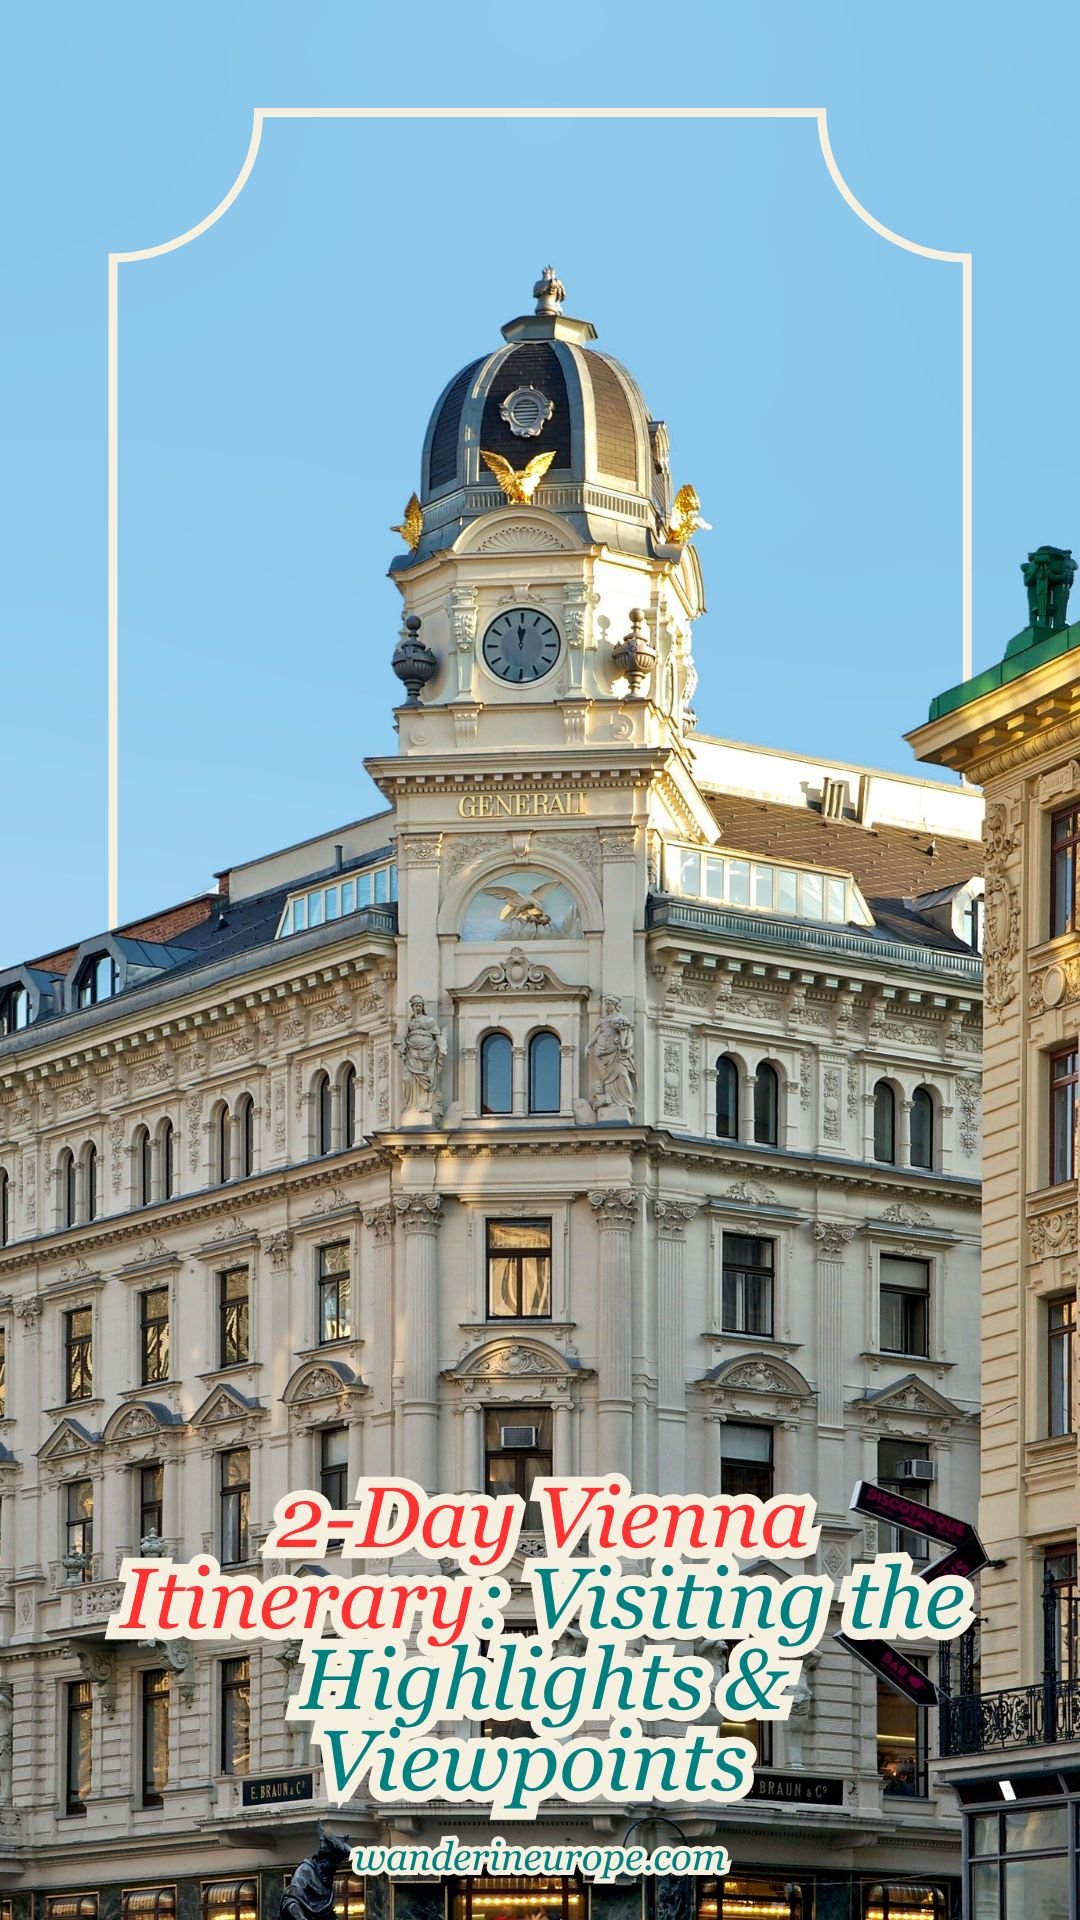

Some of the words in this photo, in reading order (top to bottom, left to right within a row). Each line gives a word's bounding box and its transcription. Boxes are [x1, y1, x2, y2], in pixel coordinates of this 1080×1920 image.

[458, 792, 587, 818] GENERALI
[866, 1487, 965, 1537] DISCOTHEQUE
[882, 1651, 908, 1677] BAR
[250, 1787, 258, 1800] E.
[260, 1782, 289, 1799] BRAUN
[760, 1780, 802, 1797] BRAUN
